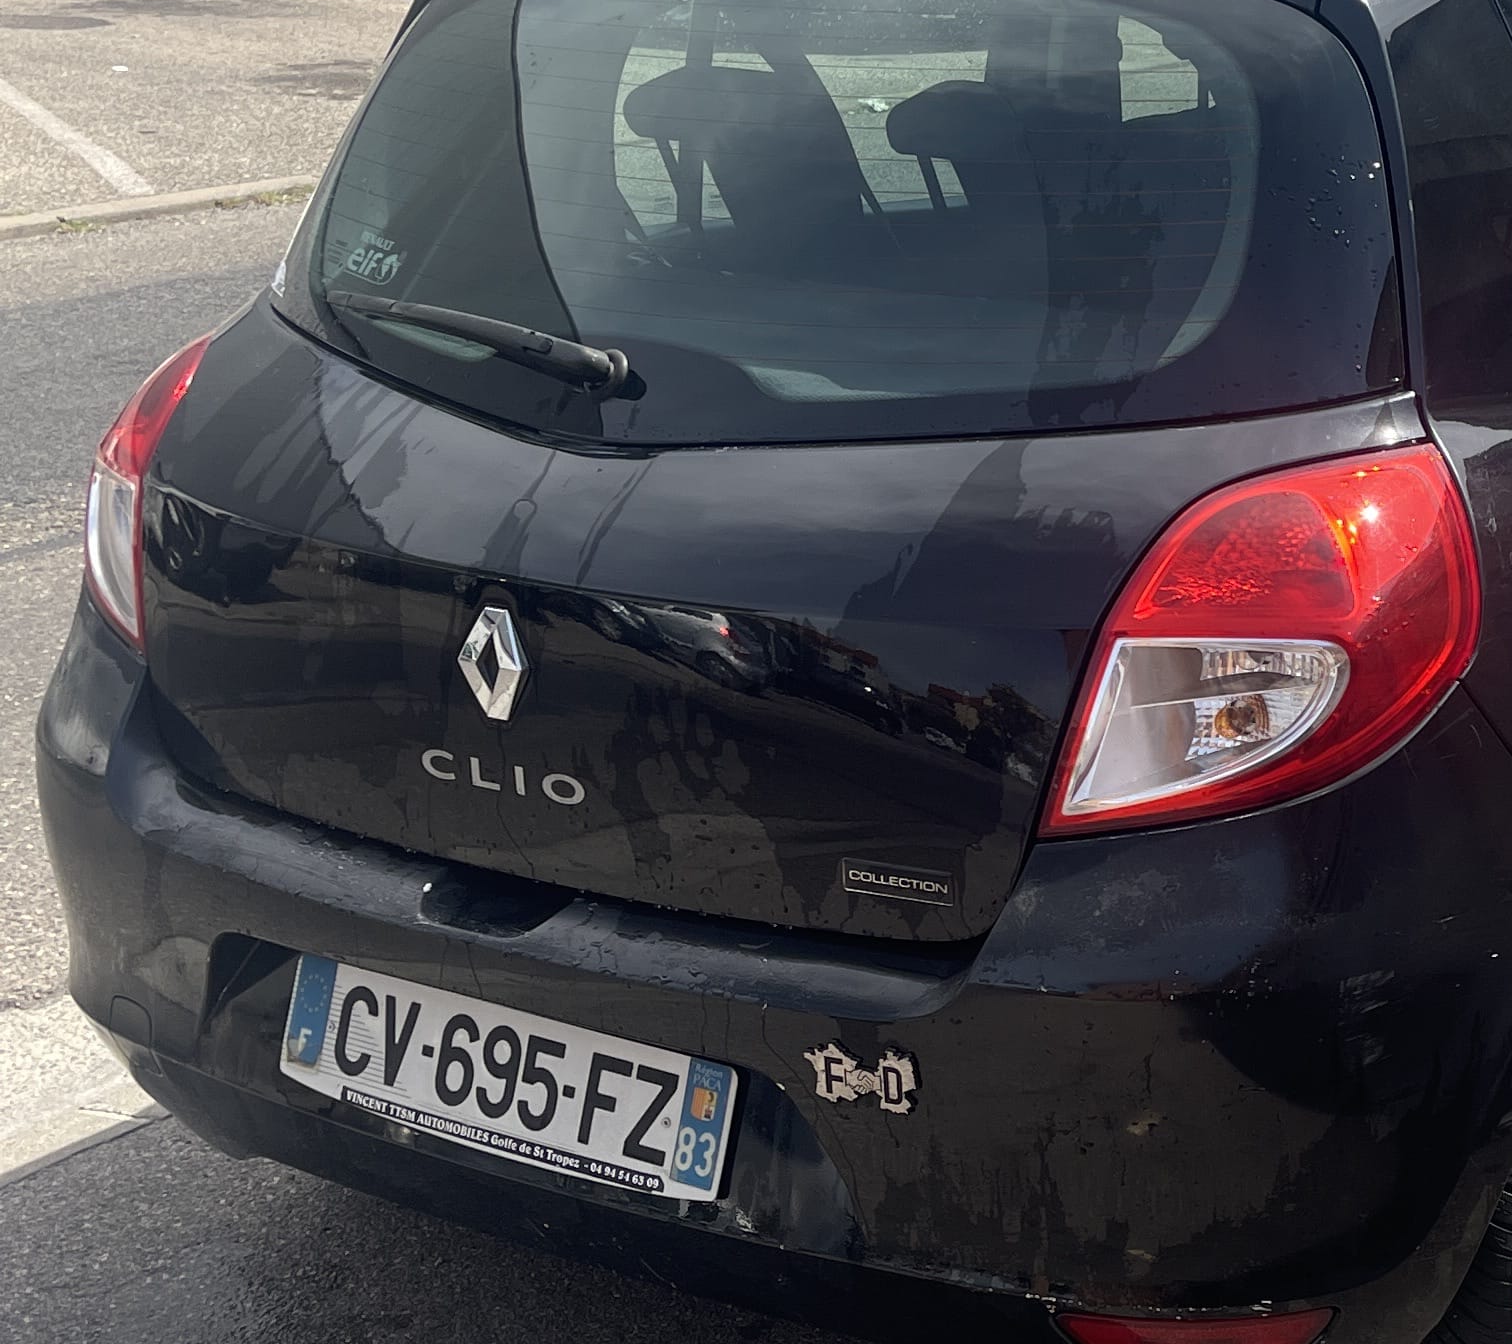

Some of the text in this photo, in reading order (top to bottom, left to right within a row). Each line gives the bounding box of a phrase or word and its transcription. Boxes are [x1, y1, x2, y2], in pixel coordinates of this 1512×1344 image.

[347, 247, 384, 276] elf
[421, 748, 586, 805] CLIO
[848, 869, 948, 894] COLLECTION
[297, 1027, 313, 1052] F
[334, 985, 680, 1167] CV-695-FZ
[692, 1073, 722, 1091] PACA
[823, 1056, 844, 1094] F
[882, 1066, 903, 1105] D
[346, 1090, 388, 1113] VINCENT
[417, 1115, 489, 1143] AUTOMOBILES
[490, 1134, 517, 1151] Golfe
[518, 1142, 532, 1155] de
[533, 1145, 545, 1158] St
[546, 1149, 580, 1168] Tropez
[590, 1162, 603, 1174] 04
[603, 1166, 616, 1178] 94
[617, 1170, 630, 1182] 54
[631, 1174, 644, 1186] 63
[646, 1177, 660, 1189] 09
[673, 1126, 717, 1178] 83
